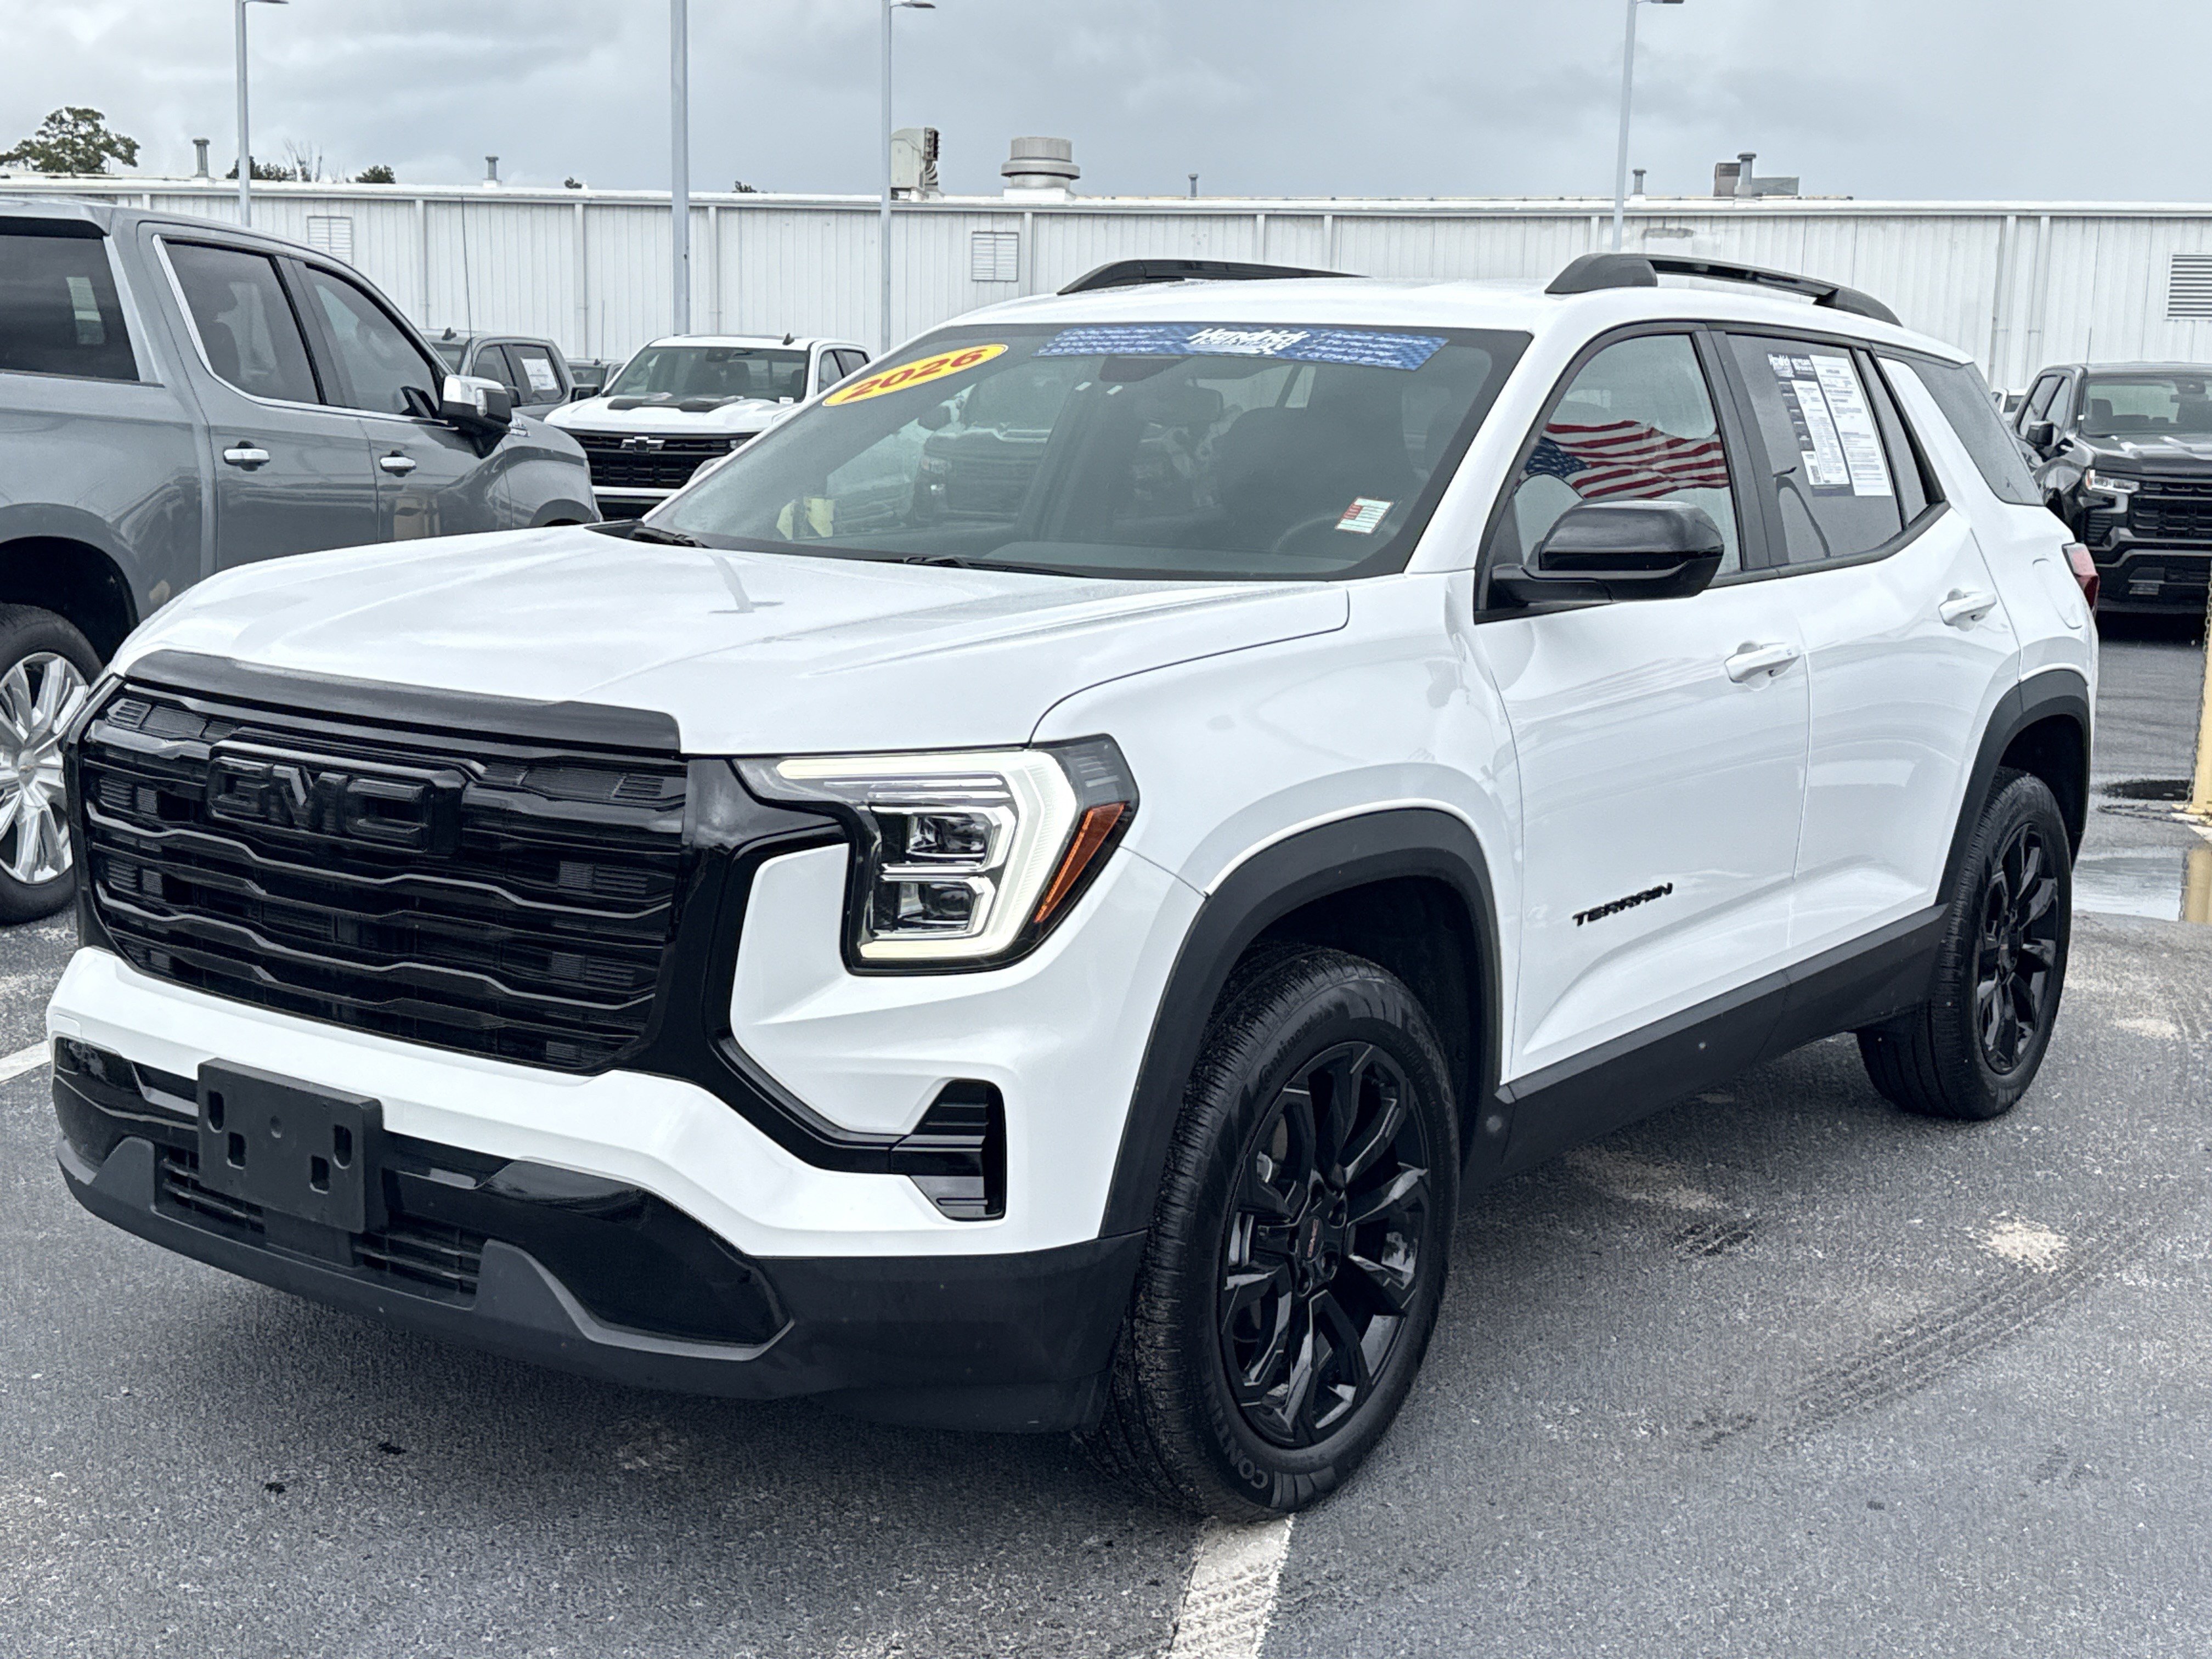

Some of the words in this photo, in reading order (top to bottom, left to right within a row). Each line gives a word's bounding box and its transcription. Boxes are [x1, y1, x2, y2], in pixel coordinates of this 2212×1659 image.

[841, 349, 988, 402] 2026
[206, 755, 429, 855] GMC
[1572, 882, 1673, 926] TERRAIN
